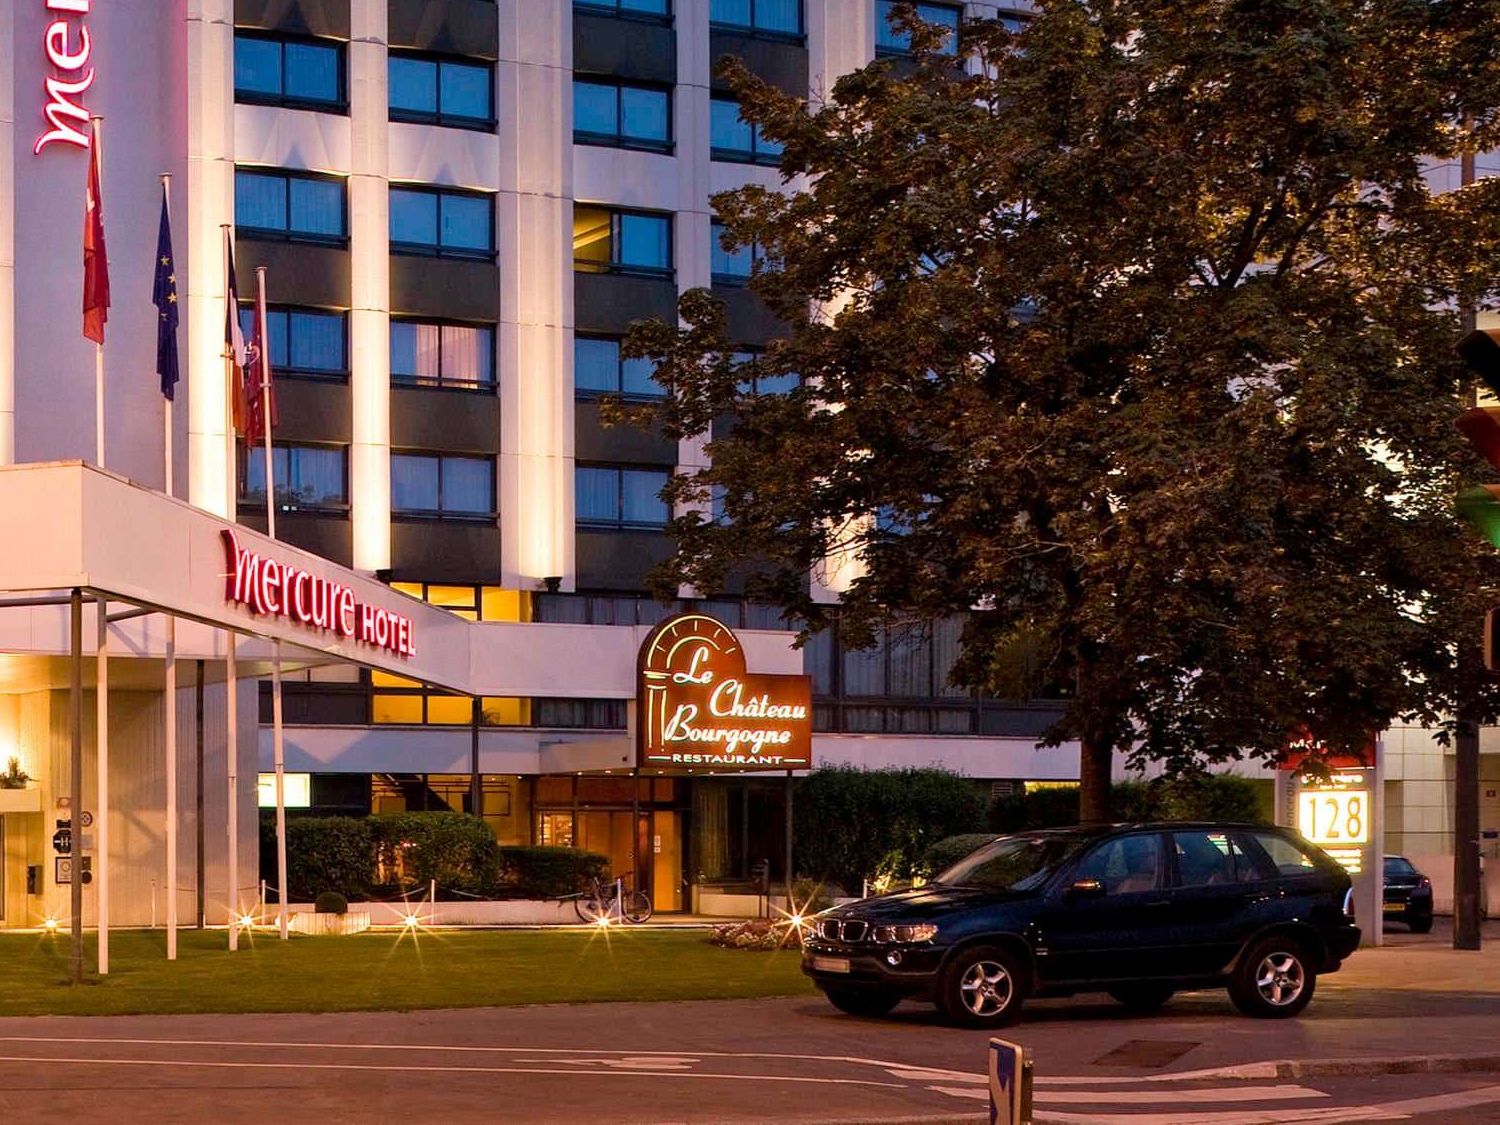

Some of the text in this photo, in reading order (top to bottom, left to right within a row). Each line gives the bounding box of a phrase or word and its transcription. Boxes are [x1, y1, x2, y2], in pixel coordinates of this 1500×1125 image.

[358, 602, 416, 658] HOTEL
[672, 646, 714, 685] Le
[709, 678, 807, 720] Château
[664, 703, 792, 754] Bourgogne
[672, 753, 784, 765] RESTAURANT
[1308, 796, 1362, 838] 128
